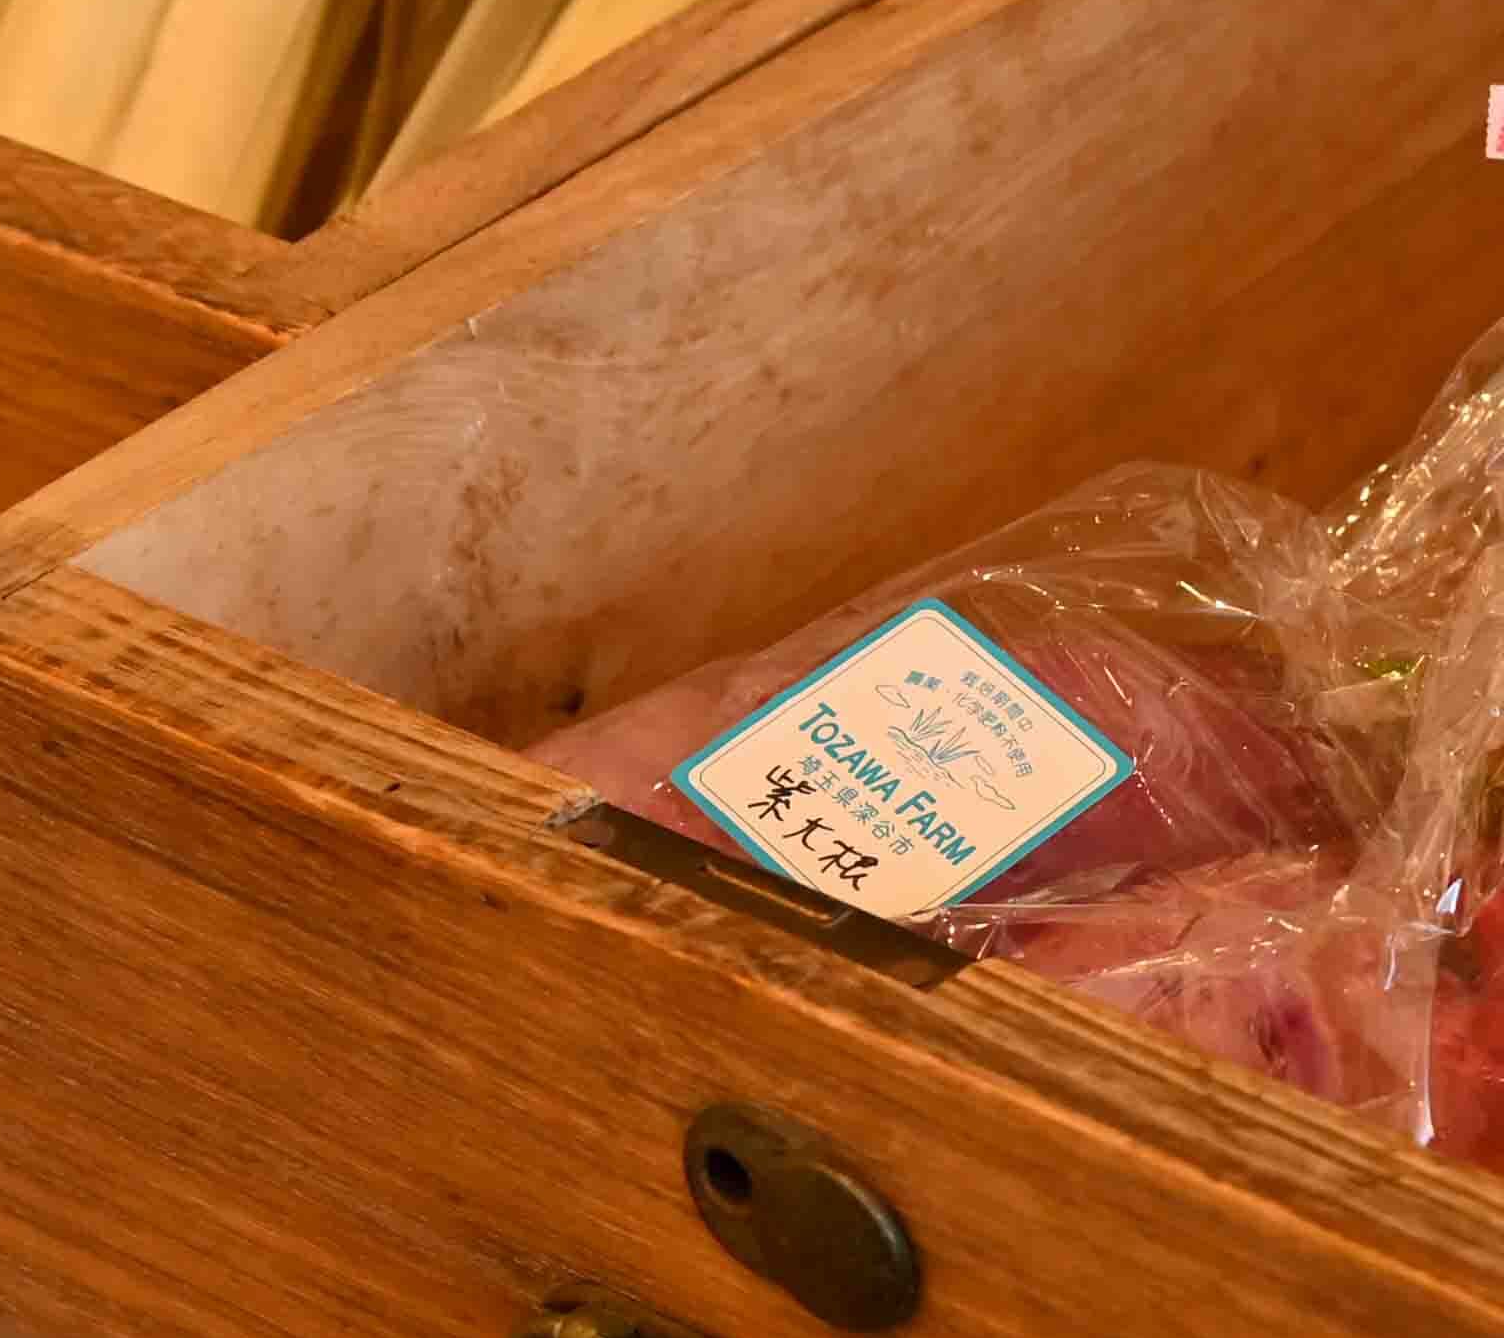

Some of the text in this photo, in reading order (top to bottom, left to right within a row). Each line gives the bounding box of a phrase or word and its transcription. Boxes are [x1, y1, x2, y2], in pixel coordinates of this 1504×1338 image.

[797, 755, 915, 856] 埼玉県深谷市
[798, 702, 977, 867] TOZAWA FARM
